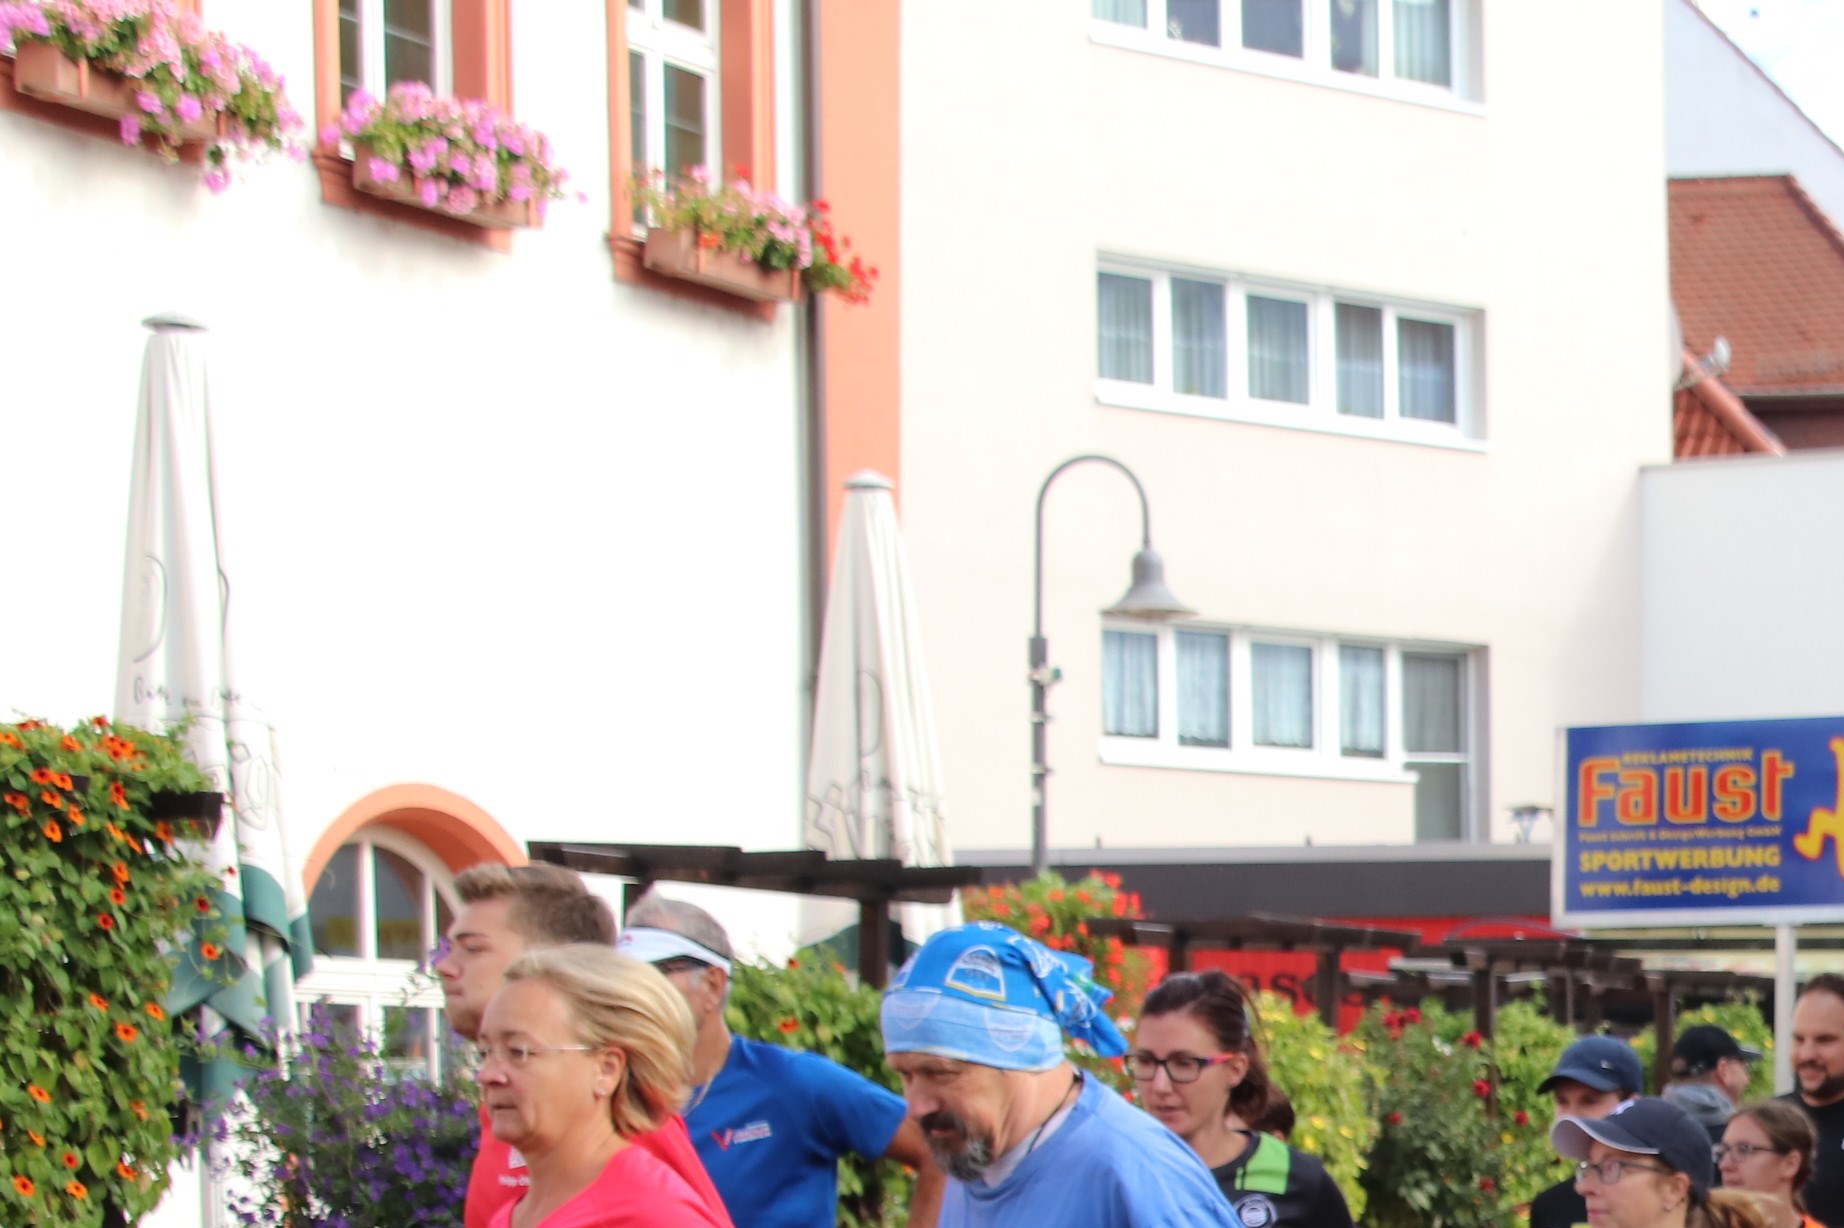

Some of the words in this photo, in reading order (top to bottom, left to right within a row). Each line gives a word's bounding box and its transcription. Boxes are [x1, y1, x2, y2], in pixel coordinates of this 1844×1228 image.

[1577, 748, 1795, 827] Faust
[1579, 846, 1781, 872] SPORTWERBUNG
[1580, 873, 1781, 899] www.faust-design.de
